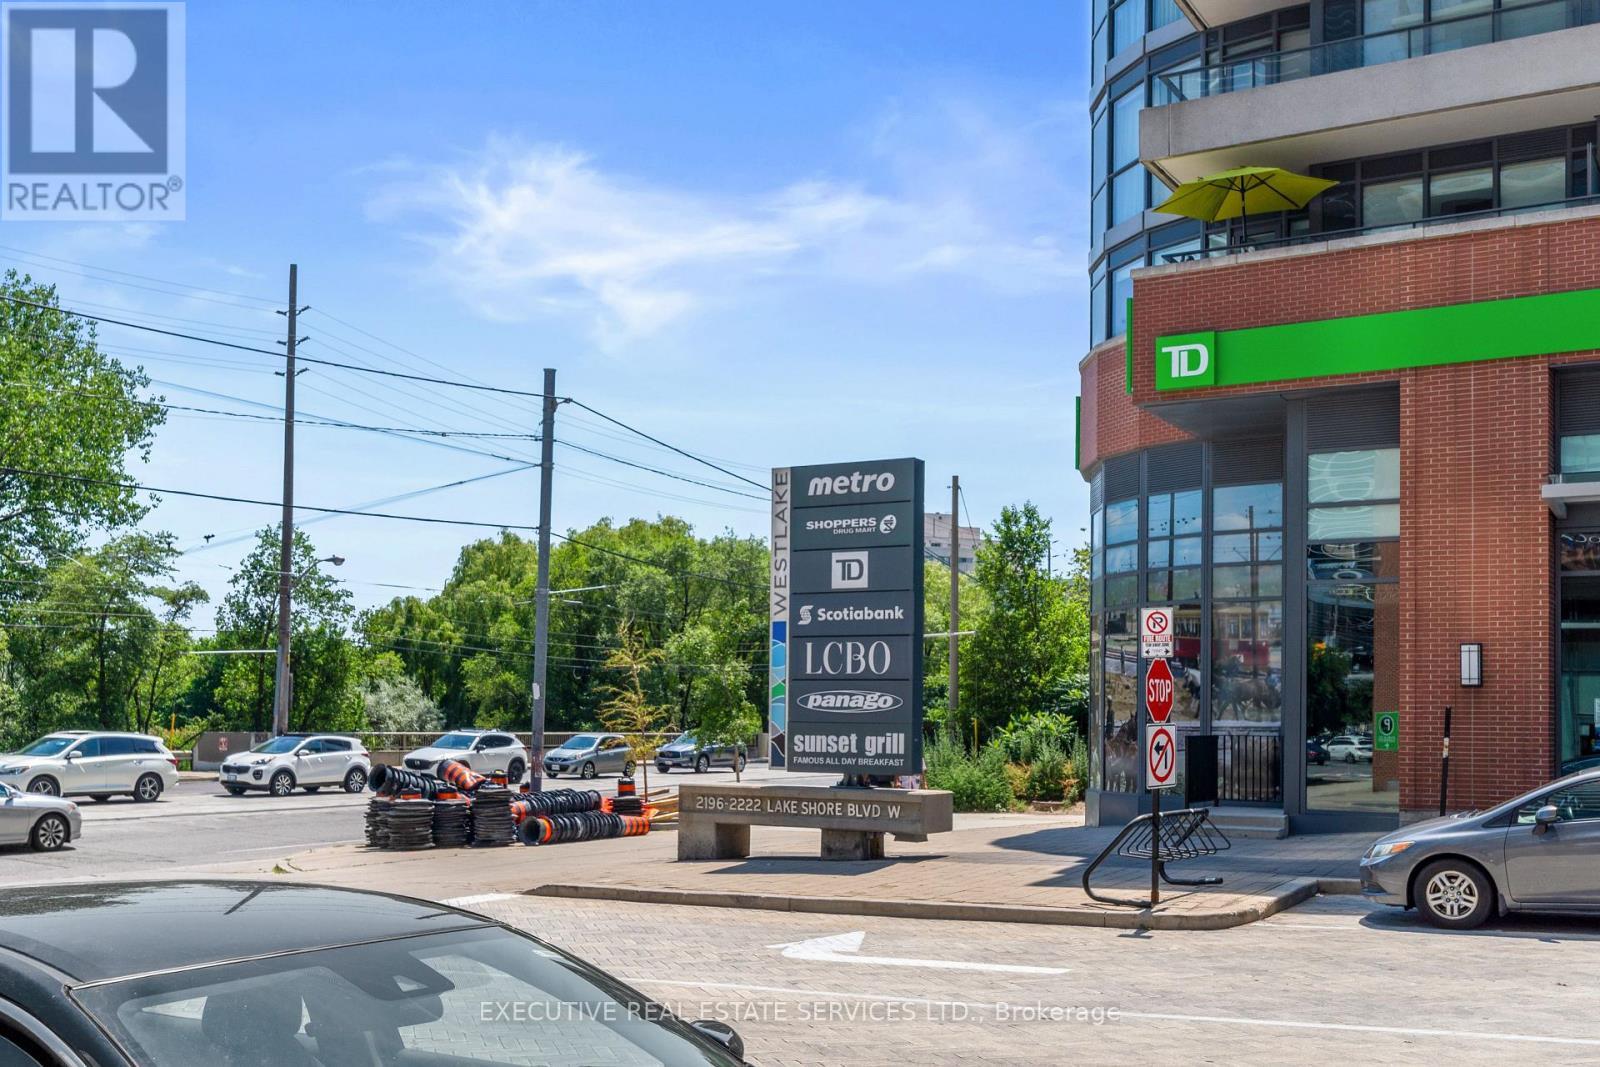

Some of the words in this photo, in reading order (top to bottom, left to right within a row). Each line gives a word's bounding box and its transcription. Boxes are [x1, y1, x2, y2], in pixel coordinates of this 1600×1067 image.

[1161, 343, 1209, 378] TD
[808, 471, 896, 497] metro
[805, 517, 877, 531] SHOPPERS
[774, 471, 788, 616] WESTLAKE
[835, 558, 864, 581] TD
[817, 605, 904, 621] Scotiabank
[805, 640, 891, 675] LCBO
[807, 692, 893, 709] panago
[1149, 678, 1171, 702] STOP
[793, 733, 858, 753] sunset
[864, 732, 905, 757] grill
[793, 756, 824, 764] FAMOUS
[825, 757, 840, 765] ALL
[858, 758, 904, 766] BREAKFAST
[695, 796, 761, 812] 2196-2222
[767, 800, 798, 814] LAKE
[801, 802, 842, 816] SHORE
[847, 804, 881, 818] BLVD
[888, 805, 901, 819] W
